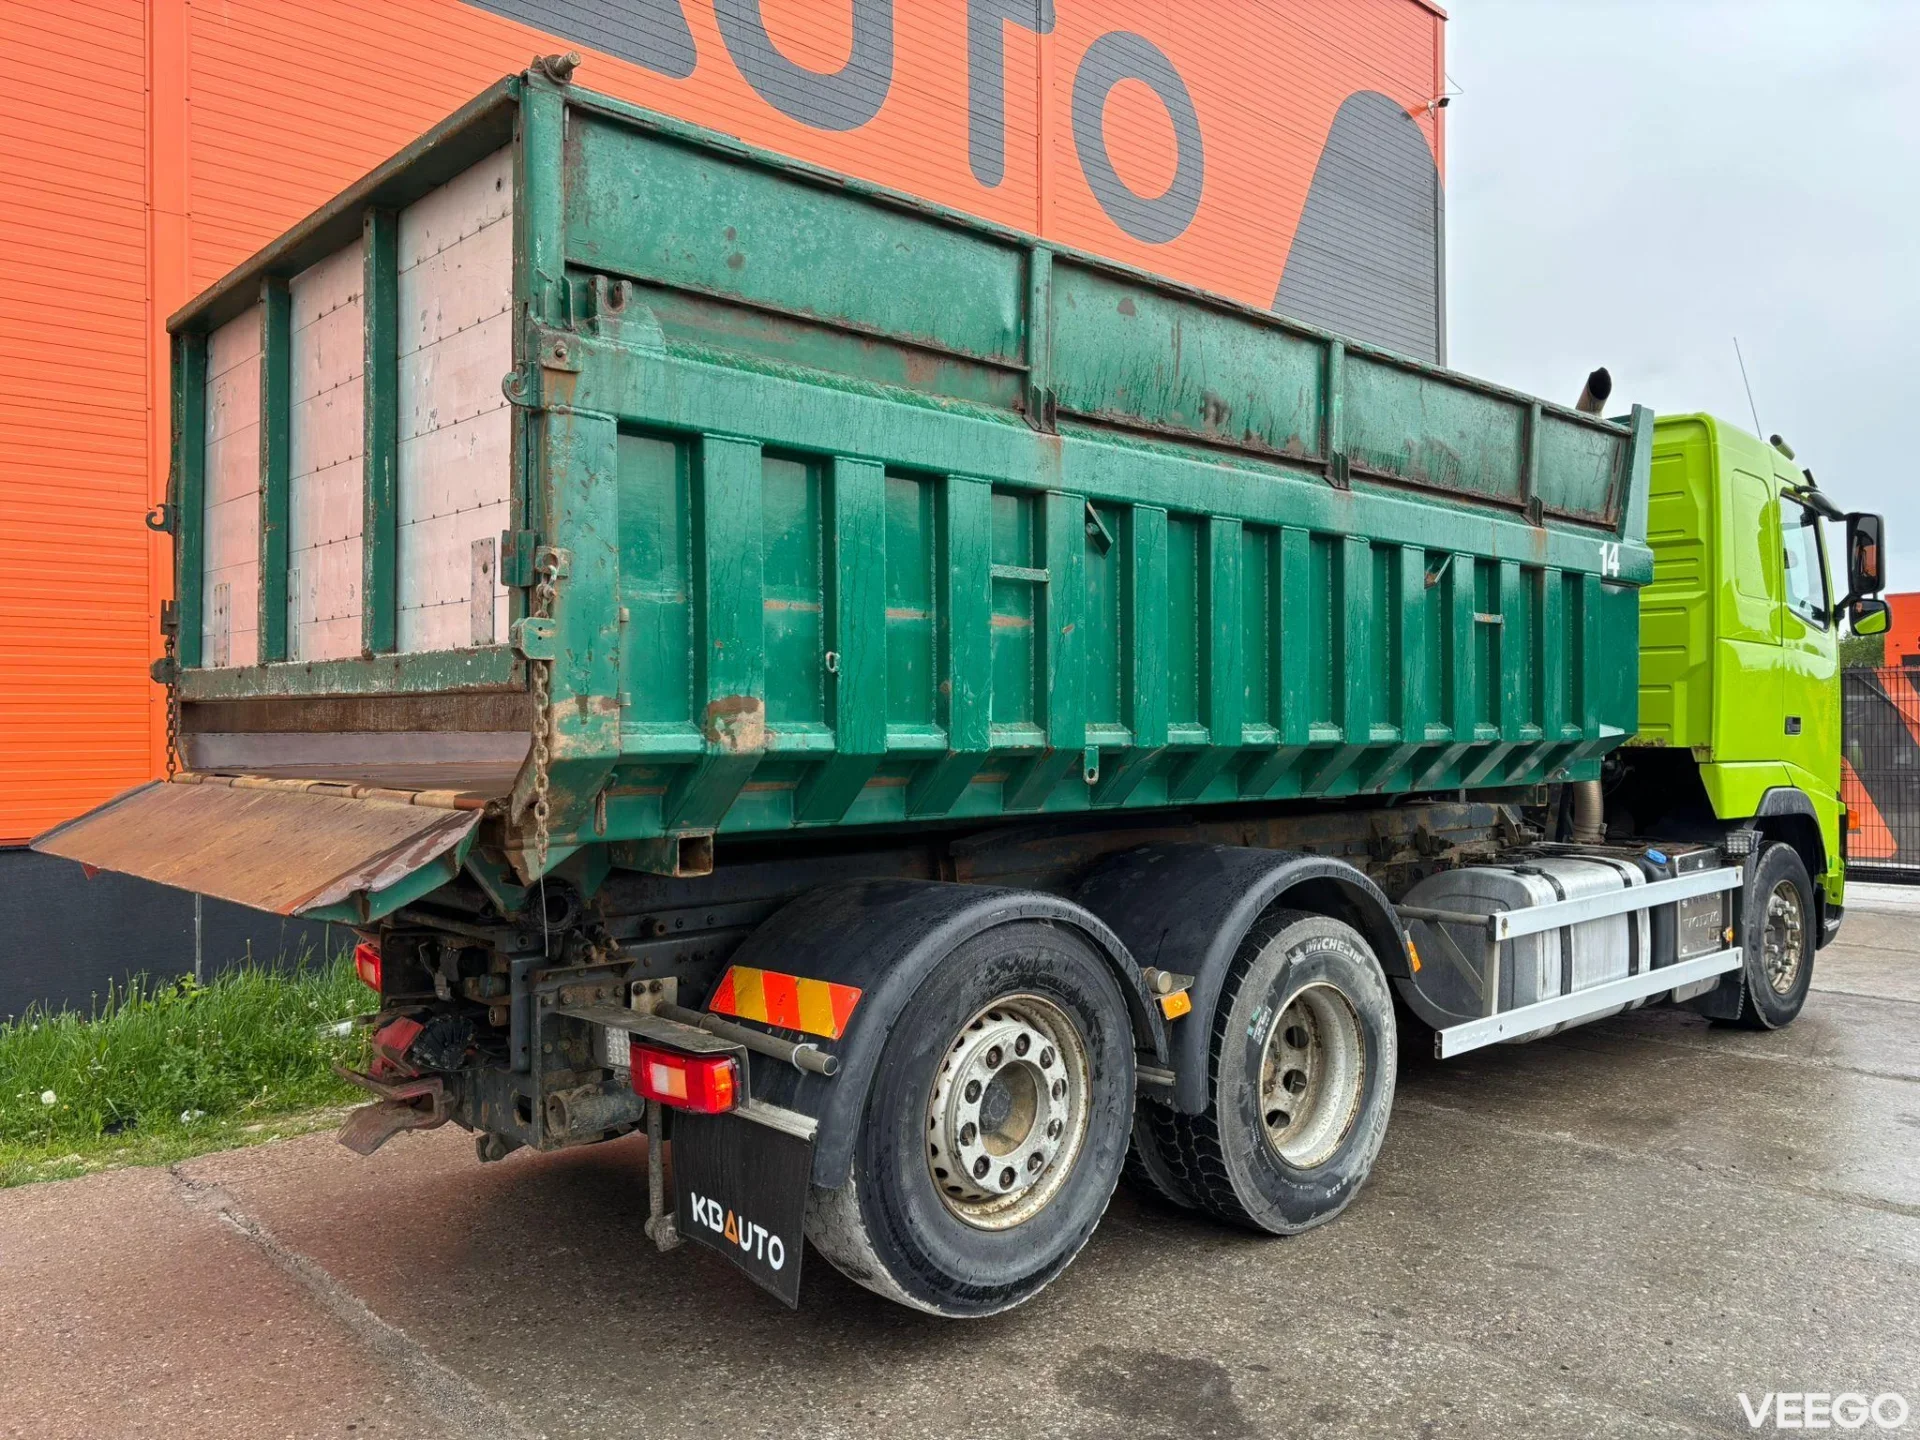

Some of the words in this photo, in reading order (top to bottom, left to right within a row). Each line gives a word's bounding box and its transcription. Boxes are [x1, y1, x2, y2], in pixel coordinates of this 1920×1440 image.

[1599, 541, 1620, 578] 14
[1305, 937, 1366, 965] MICHELIN
[691, 1191, 785, 1271] KBAUTO
